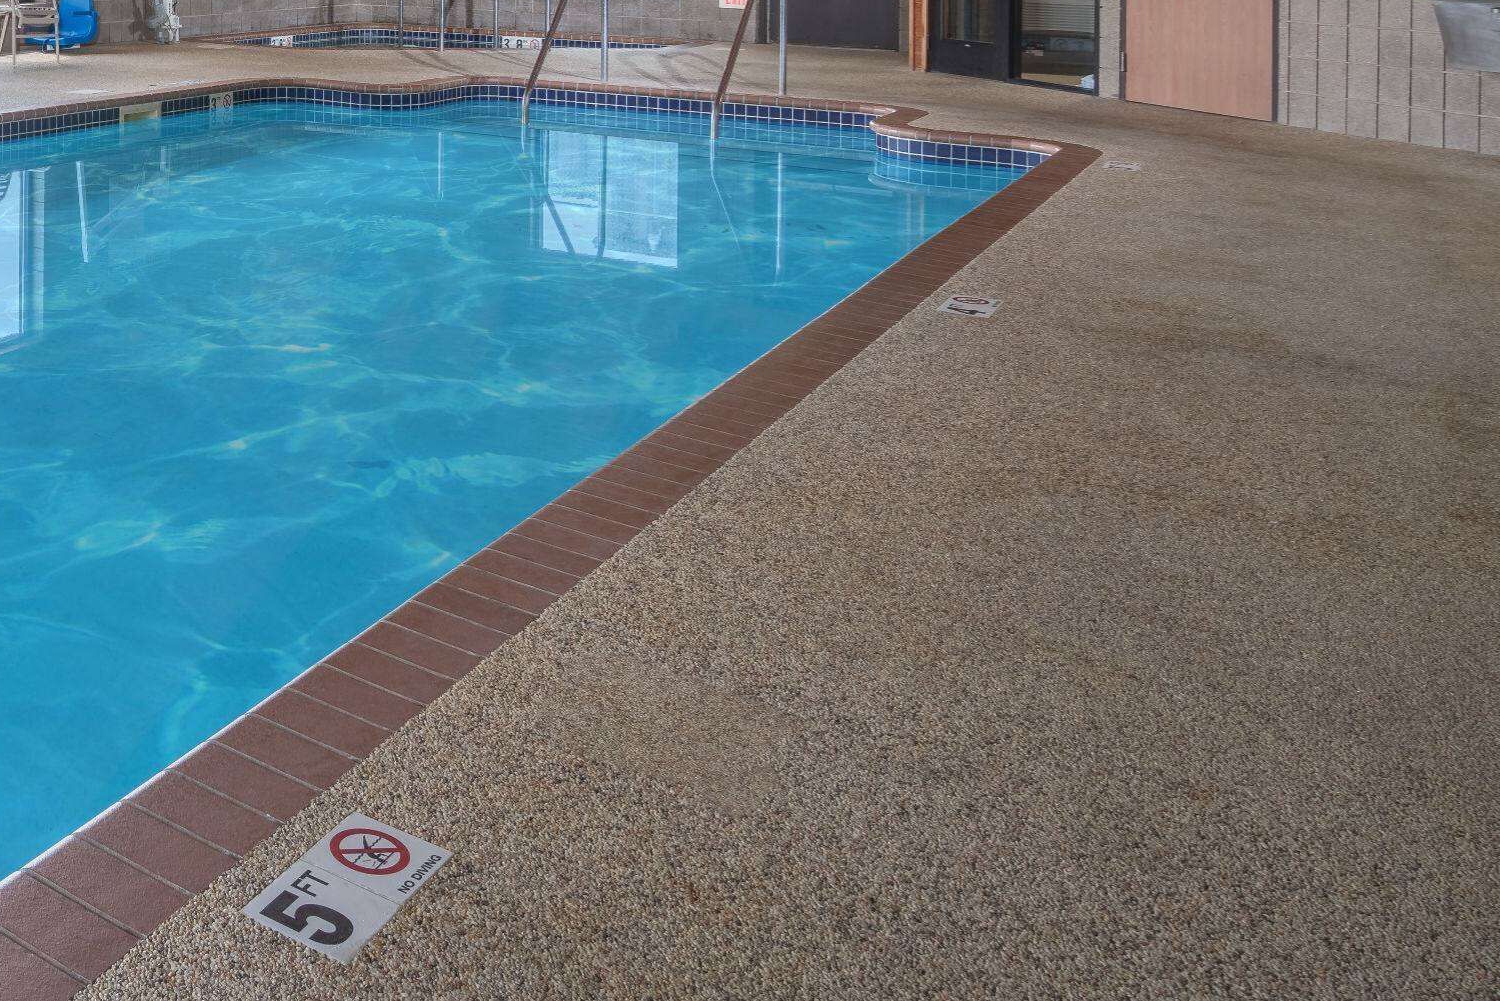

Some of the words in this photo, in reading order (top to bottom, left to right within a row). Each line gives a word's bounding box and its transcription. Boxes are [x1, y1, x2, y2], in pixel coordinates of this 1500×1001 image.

[289, 869, 329, 897] FT
[397, 880, 415, 894] NO
[411, 854, 442, 881] DIVING
[259, 890, 354, 946] 5
